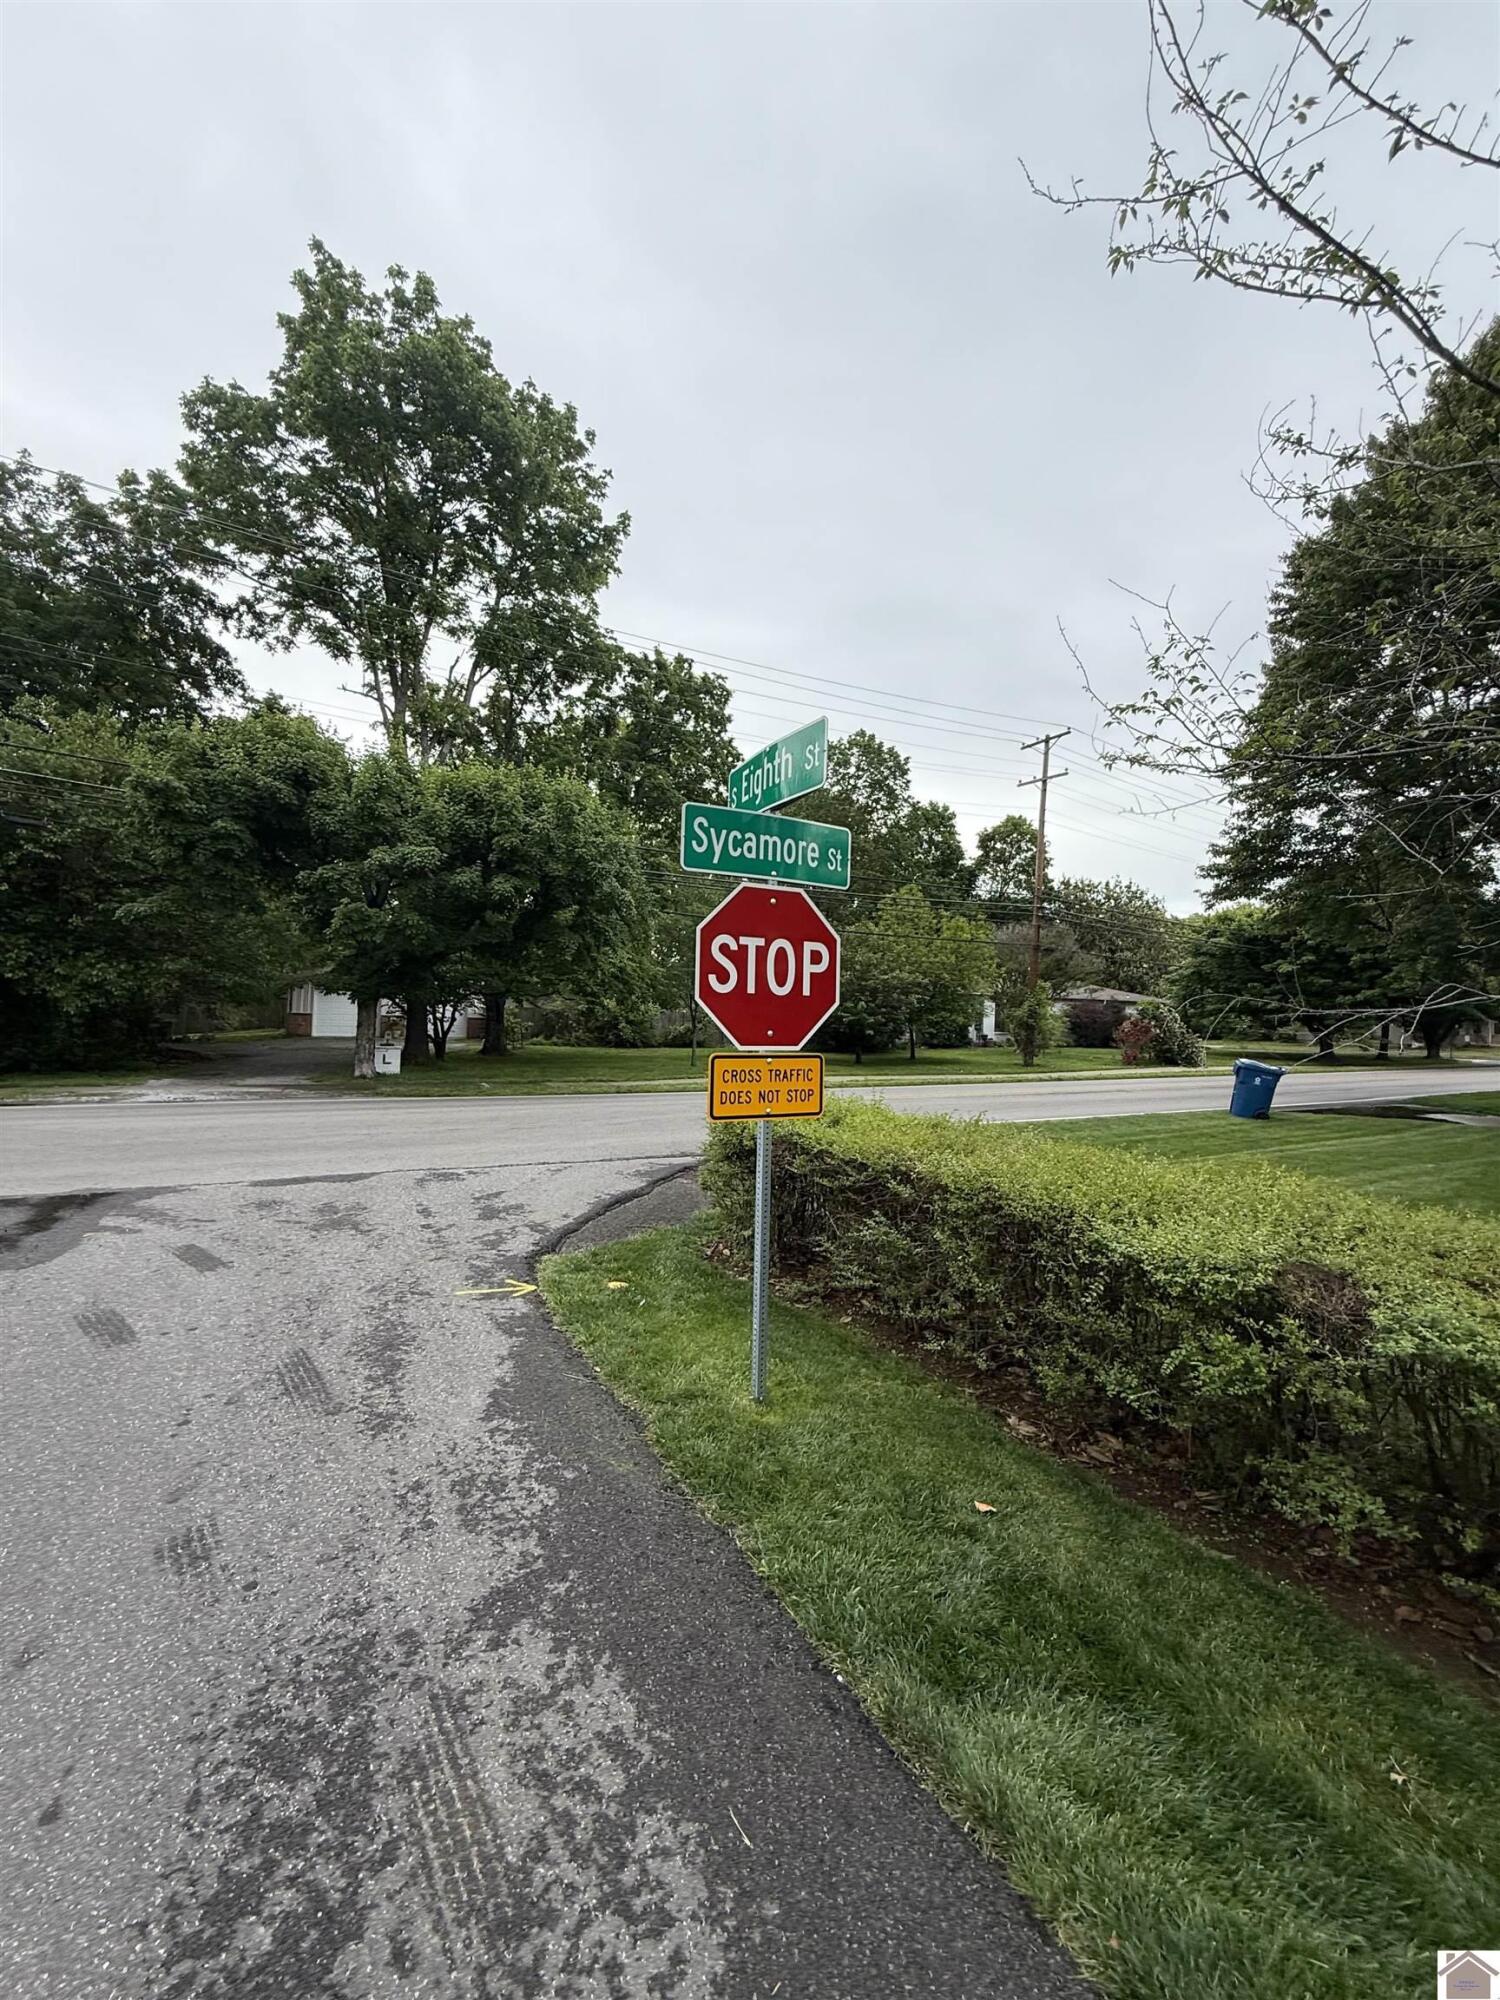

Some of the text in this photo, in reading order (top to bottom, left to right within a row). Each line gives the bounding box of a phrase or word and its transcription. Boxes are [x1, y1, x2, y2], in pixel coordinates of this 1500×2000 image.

[731, 742, 820, 809] S Eighth St
[691, 816, 843, 872] Sycamore St
[707, 934, 830, 997] STOP
[719, 1088, 815, 1105] DOES NOT STOP
[722, 1068, 814, 1083] CROSS TRAFFIC
